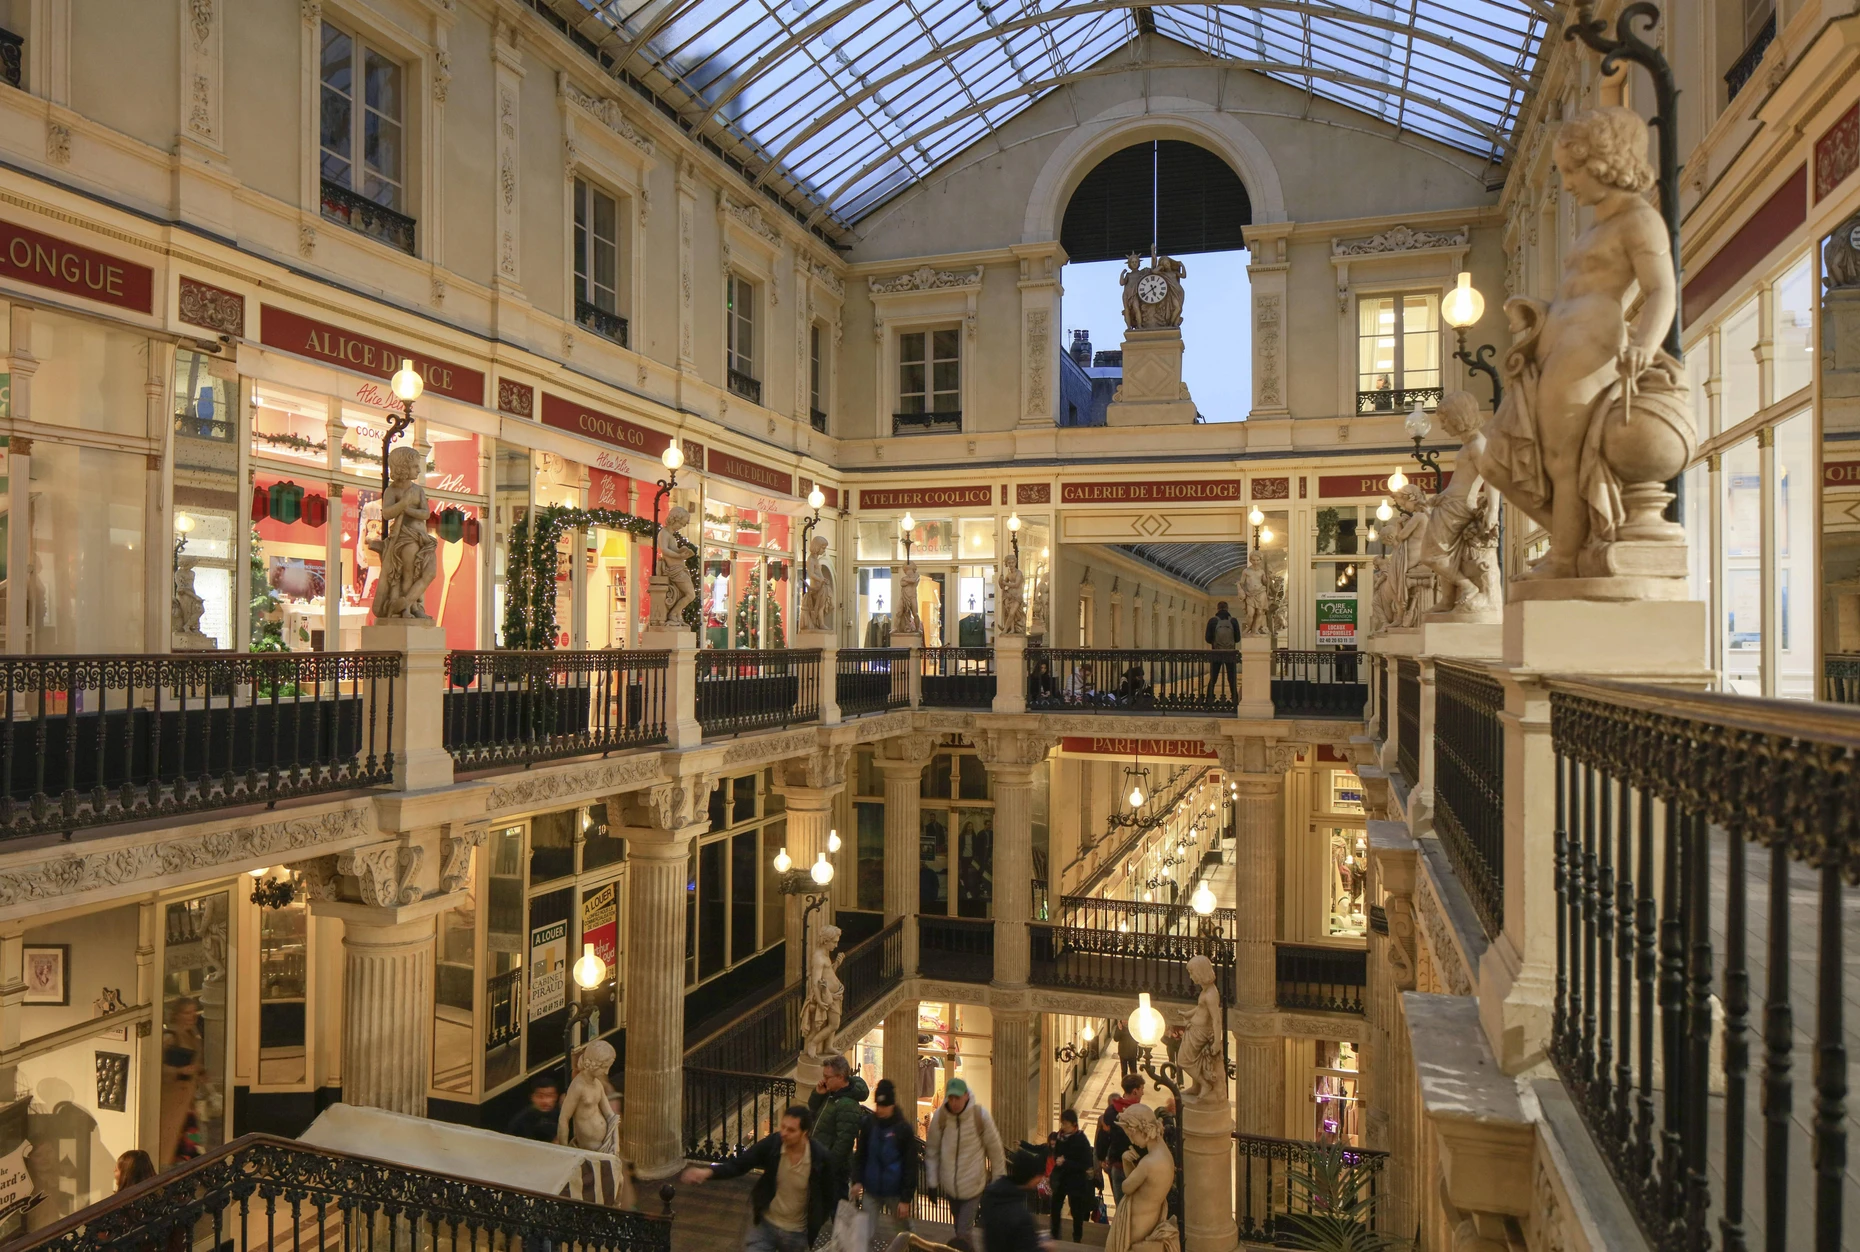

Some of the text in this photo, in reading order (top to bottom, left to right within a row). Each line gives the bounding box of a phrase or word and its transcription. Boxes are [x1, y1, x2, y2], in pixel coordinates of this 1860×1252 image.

[0, 237, 124, 297] ONGUE
[304, 328, 453, 391] ALICE DEICE
[579, 414, 645, 446] COOK & GO
[724, 460, 779, 488] ALICE DELICE
[862, 490, 991, 505] ATELIER COQLICO
[1064, 484, 1238, 500] GALERIE DE L'HORLOGE
[1092, 737, 1208, 756] PARFUMERIE
[598, 824, 606, 835] 10
[584, 888, 612, 915] A LOUER
[535, 926, 564, 945] A LOUER
[532, 971, 564, 990] CABINET
[532, 980, 564, 1000] PIRAUD
[0, 1168, 8, 1176] he
[0, 1172, 26, 1190] ard's
